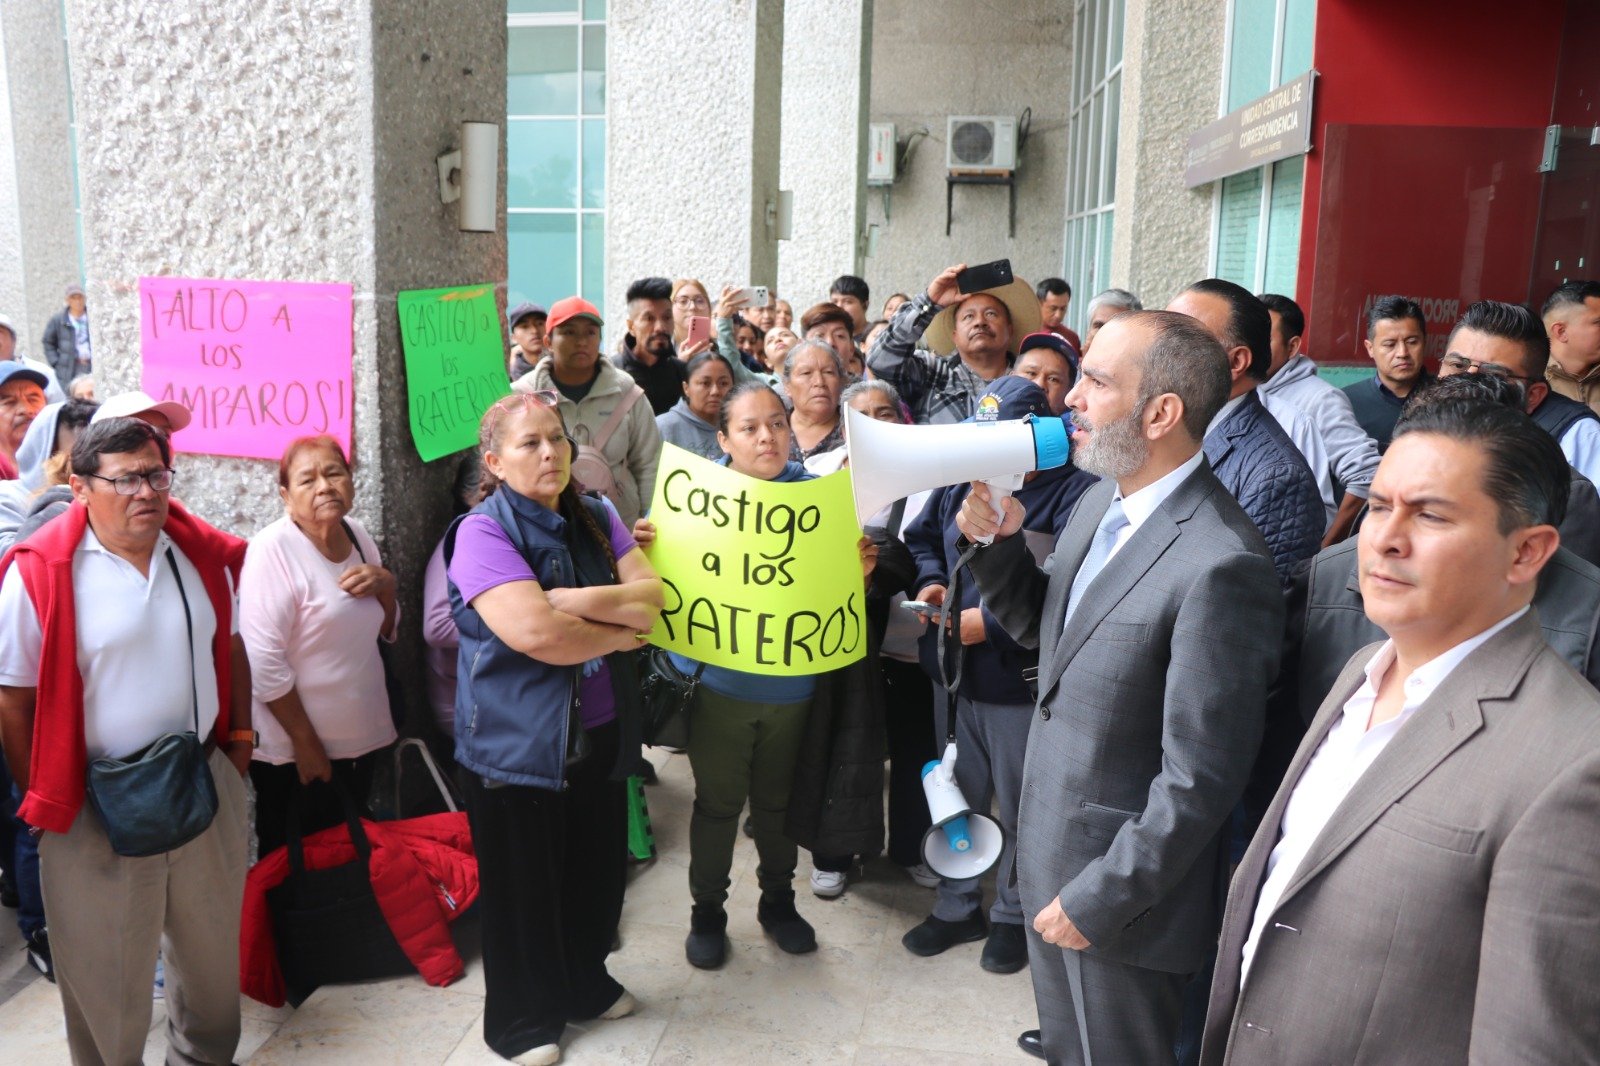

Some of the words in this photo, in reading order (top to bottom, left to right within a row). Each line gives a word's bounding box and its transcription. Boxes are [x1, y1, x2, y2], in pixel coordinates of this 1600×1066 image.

[1241, 104, 1263, 127] UNIDAD
[1263, 88, 1291, 117] CENTRAL
[1291, 83, 1302, 103] DE
[1239, 110, 1298, 149] CORRESPONDENCIA
[272, 304, 293, 333] A
[406, 298, 476, 348] CASTIGO
[663, 468, 821, 560] Castigo
[702, 552, 721, 577] a
[743, 552, 797, 587] los
[659, 576, 861, 667] RATEROS
